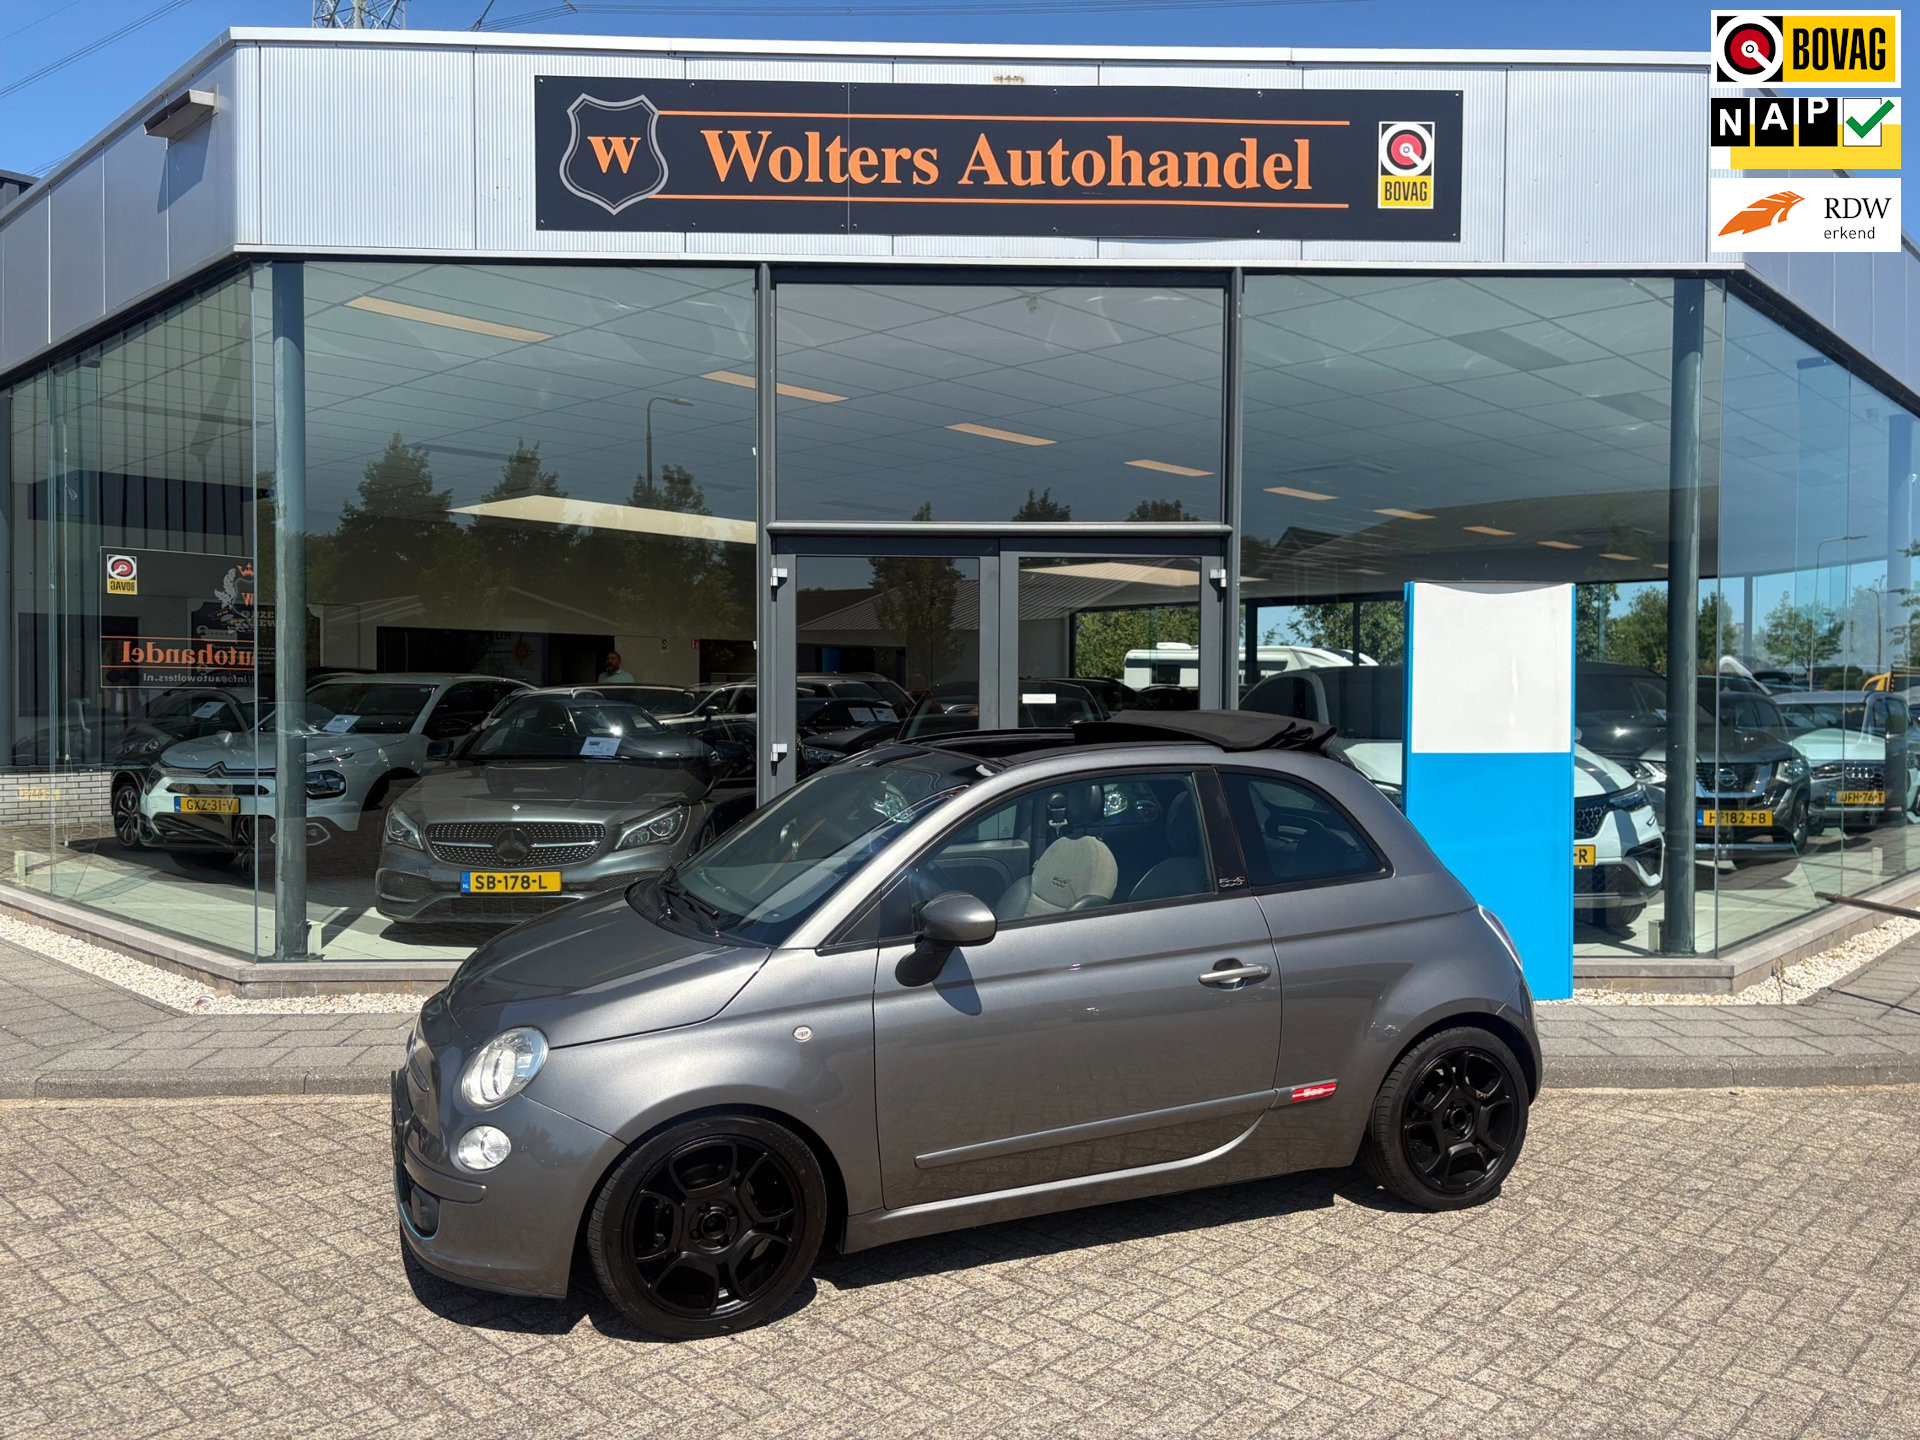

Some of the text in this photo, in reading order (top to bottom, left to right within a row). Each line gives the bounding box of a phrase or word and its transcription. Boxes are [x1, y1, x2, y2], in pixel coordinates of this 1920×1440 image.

[587, 136, 641, 175] W
[700, 129, 1313, 191] Wolters Autohandel
[1384, 180, 1428, 203] BOVAG
[186, 799, 233, 813] GXZ-31-V
[474, 875, 548, 891] SB-178-L
